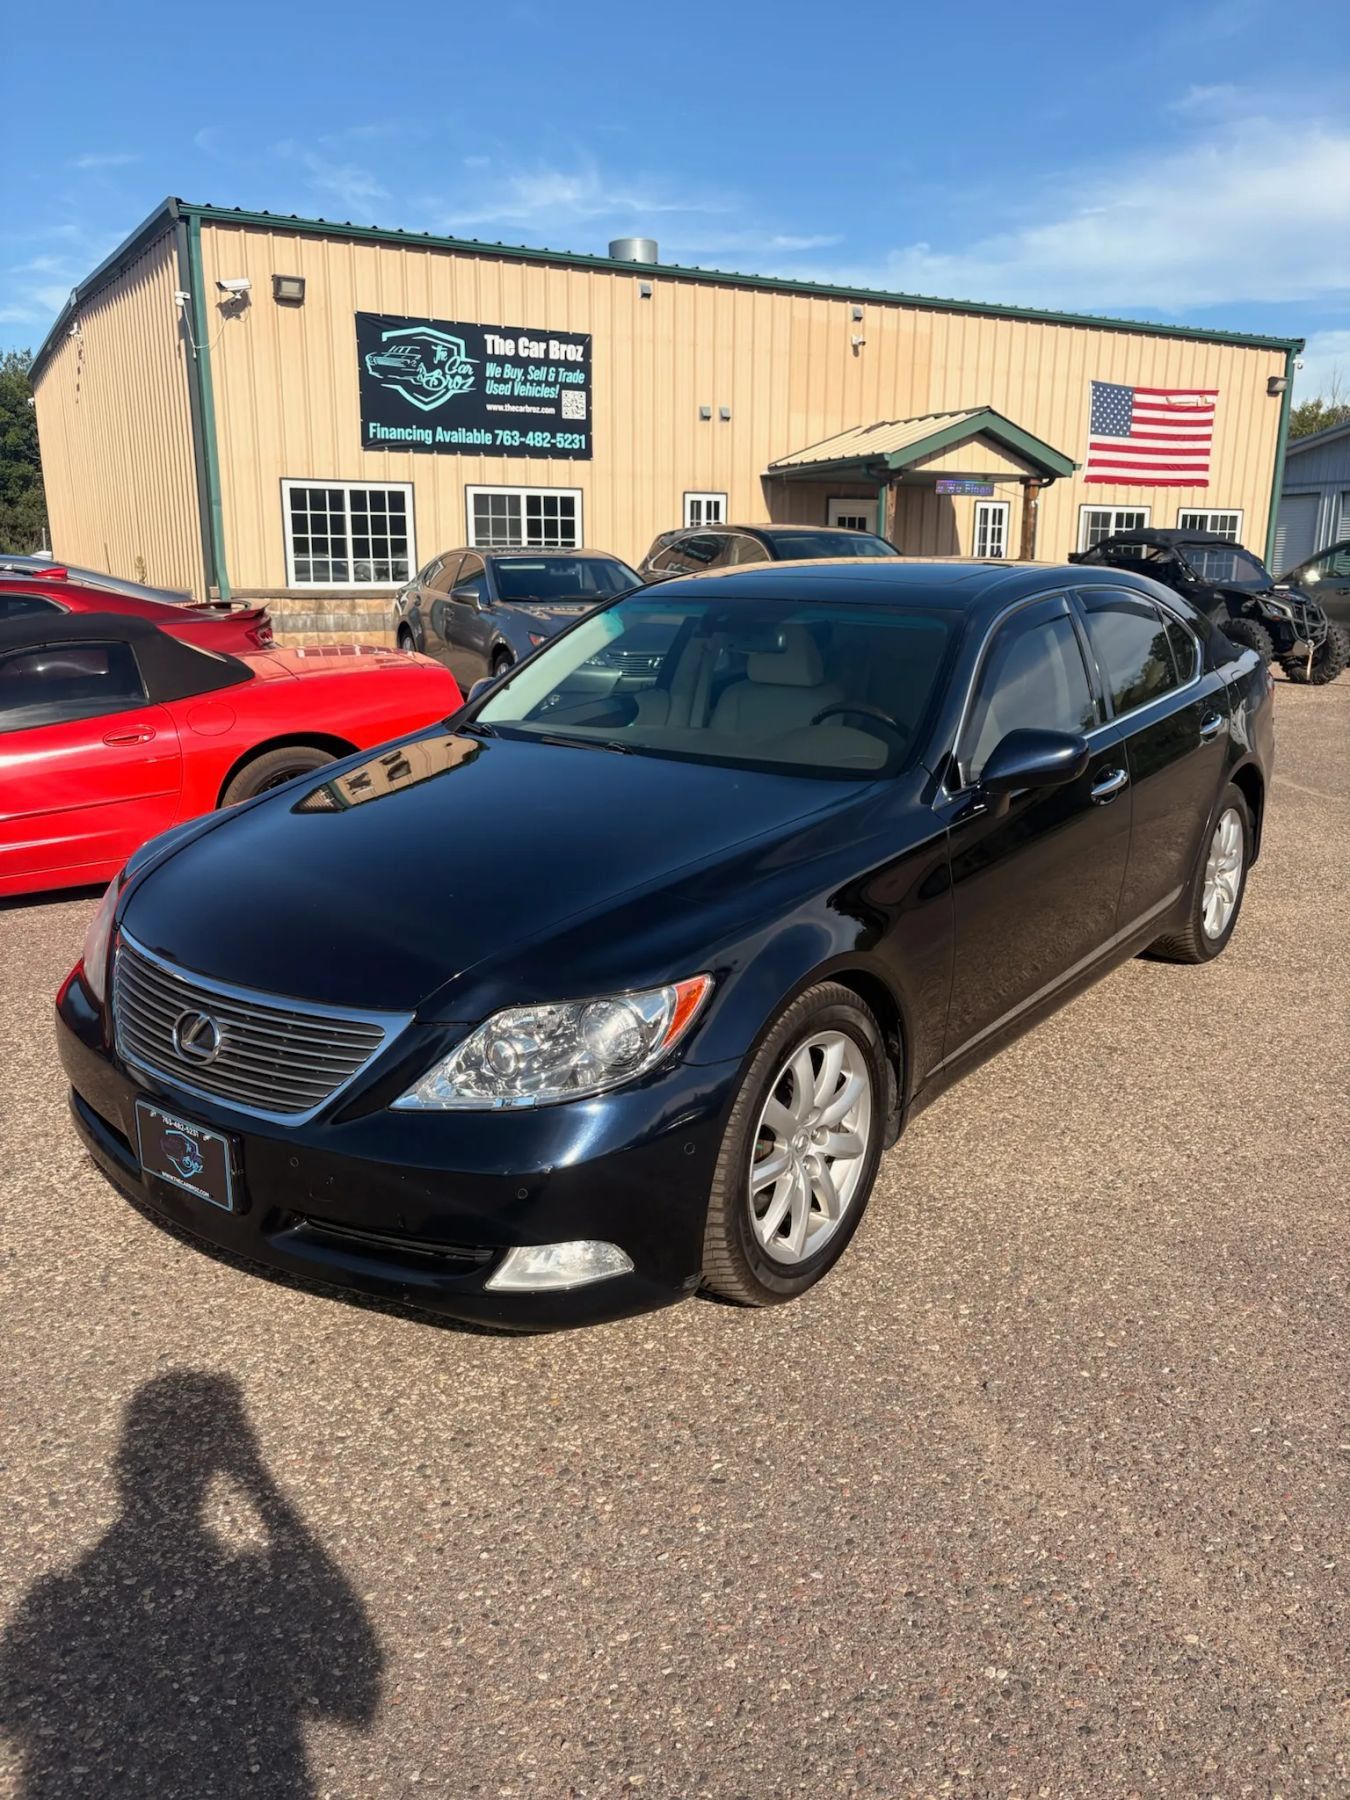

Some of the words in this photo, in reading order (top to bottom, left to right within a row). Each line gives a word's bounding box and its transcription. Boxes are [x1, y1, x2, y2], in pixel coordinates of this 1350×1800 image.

[483, 334, 516, 356] The
[518, 336, 547, 358] Car
[548, 340, 584, 362] Broz
[485, 362, 502, 378] We
[503, 363, 525, 382] Buy,
[526, 365, 547, 381] Sell
[547, 367, 557, 383] &
[558, 368, 585, 385] Trade
[485, 379, 512, 396] Used
[513, 381, 560, 399] Vehicles!
[485, 403, 556, 415] www.thecarbroz.com
[368, 422, 433, 445] Financing
[434, 426, 493, 445] Available
[494, 429, 586, 449] 763-482-5231
